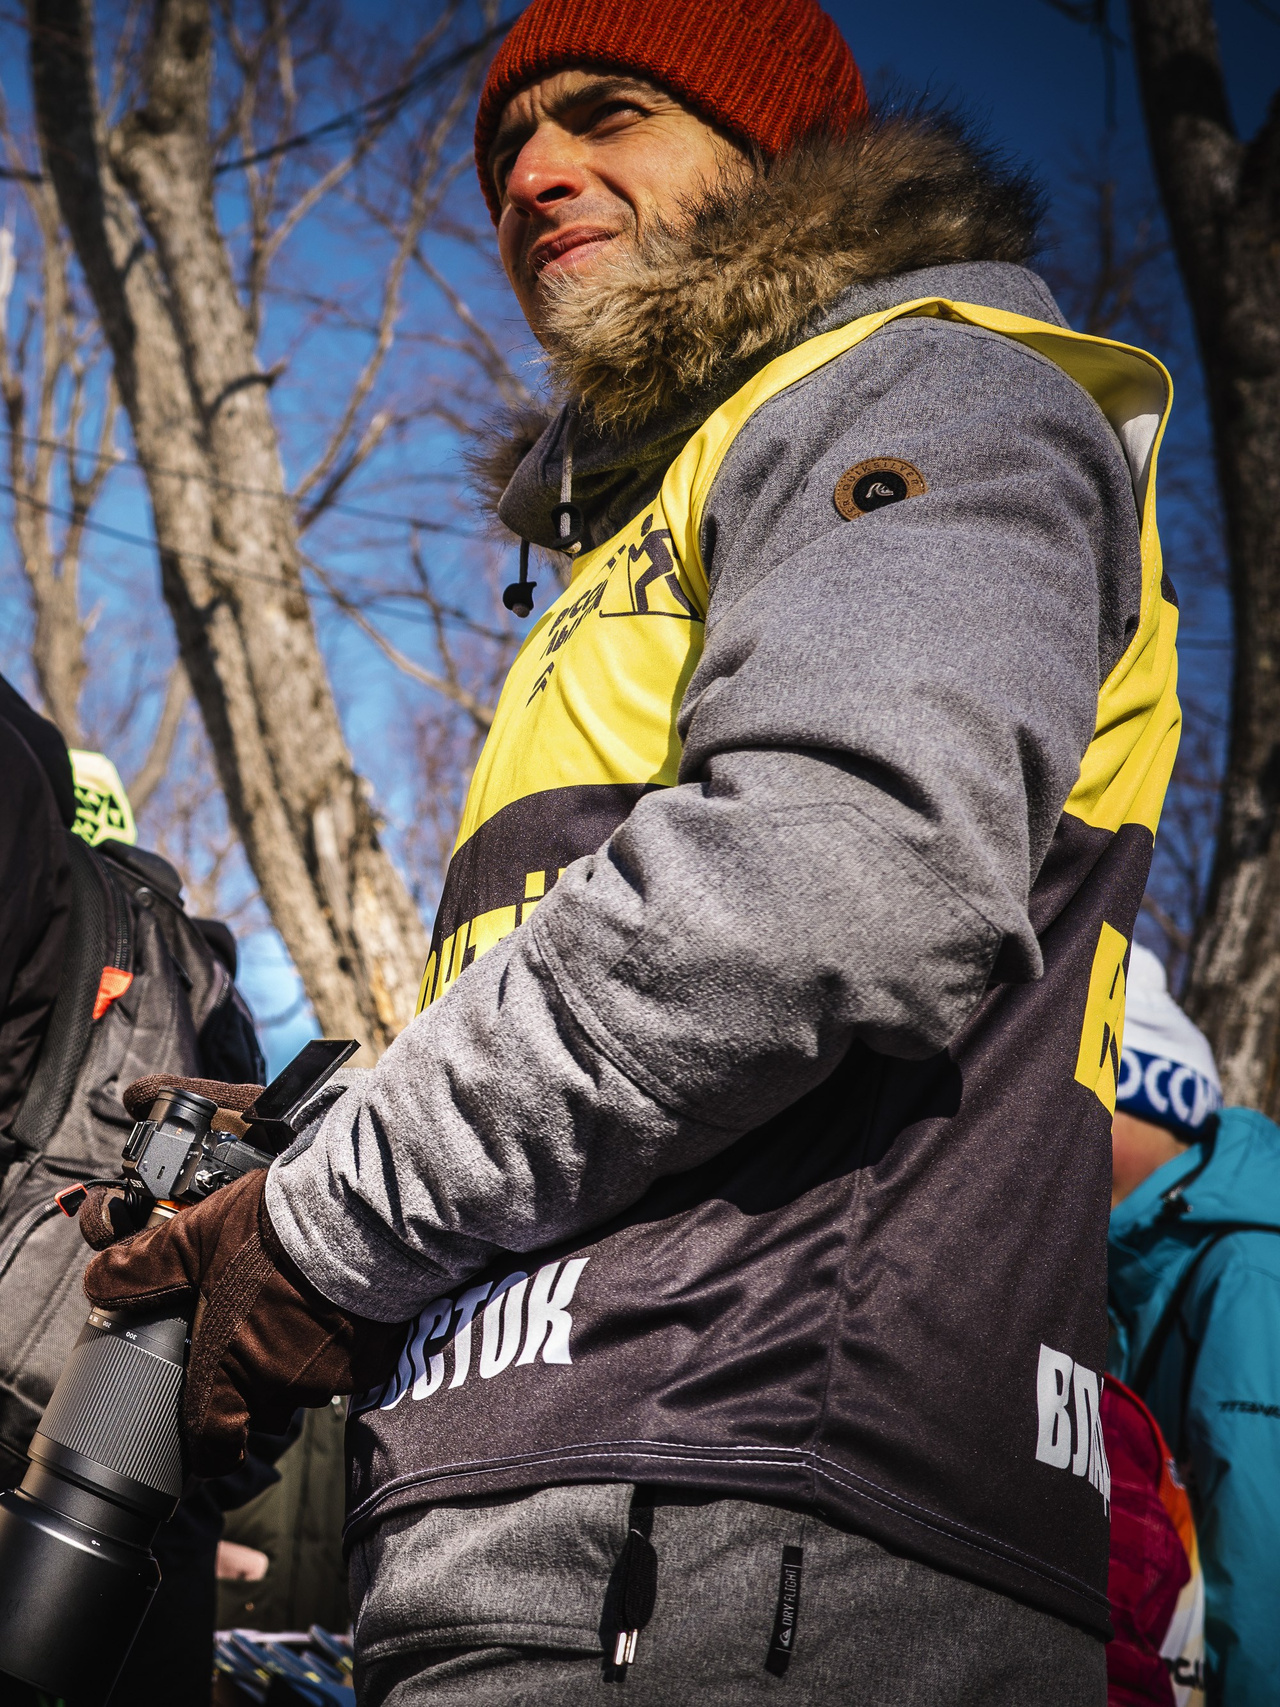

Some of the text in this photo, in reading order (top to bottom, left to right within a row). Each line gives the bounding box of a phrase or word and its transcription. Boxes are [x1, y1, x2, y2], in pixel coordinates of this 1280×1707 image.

[842, 461, 920, 491] QUIKSILVER
[782, 1569, 798, 1626] DRY FLIGHT
